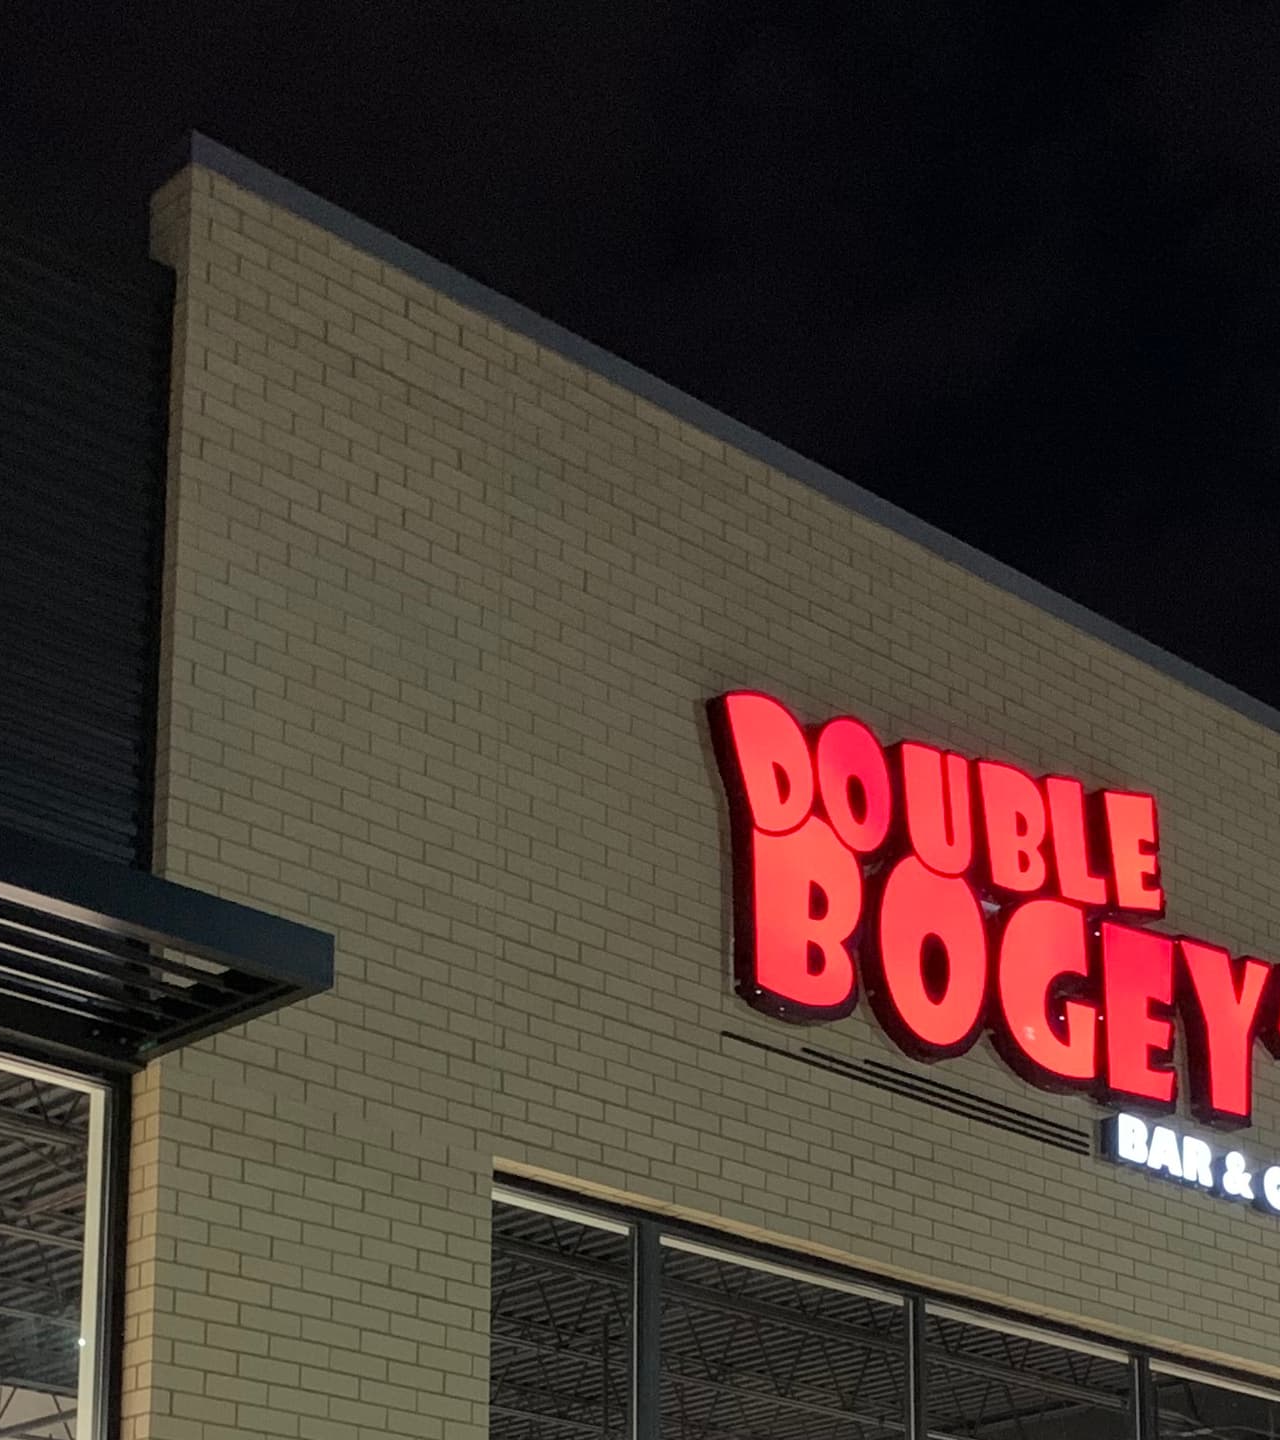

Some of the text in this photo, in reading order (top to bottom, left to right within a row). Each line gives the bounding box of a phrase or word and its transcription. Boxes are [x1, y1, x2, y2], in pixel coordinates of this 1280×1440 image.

[723, 690, 1164, 913] DOUBLE
[1117, 1112, 1214, 1188] BAR
[1222, 1151, 1255, 1200] &
